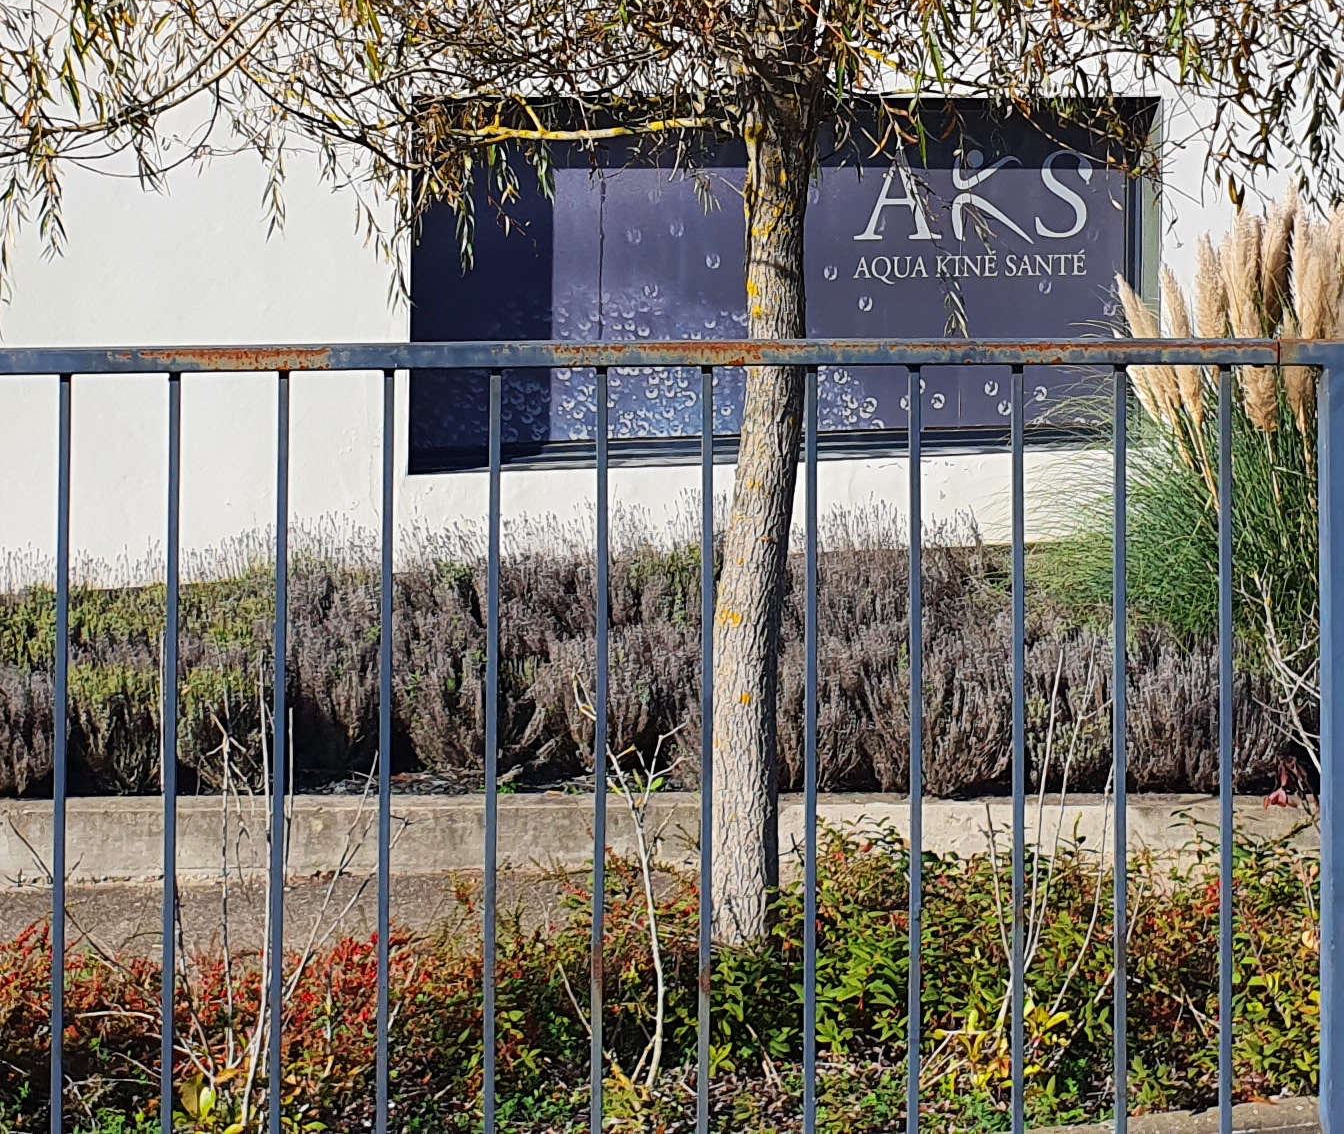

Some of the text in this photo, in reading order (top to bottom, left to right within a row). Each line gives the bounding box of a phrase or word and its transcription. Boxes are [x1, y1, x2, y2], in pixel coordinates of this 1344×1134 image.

[854, 149, 1093, 244] AKS
[853, 249, 1087, 284] AQUA KINÉ SANTÉ
